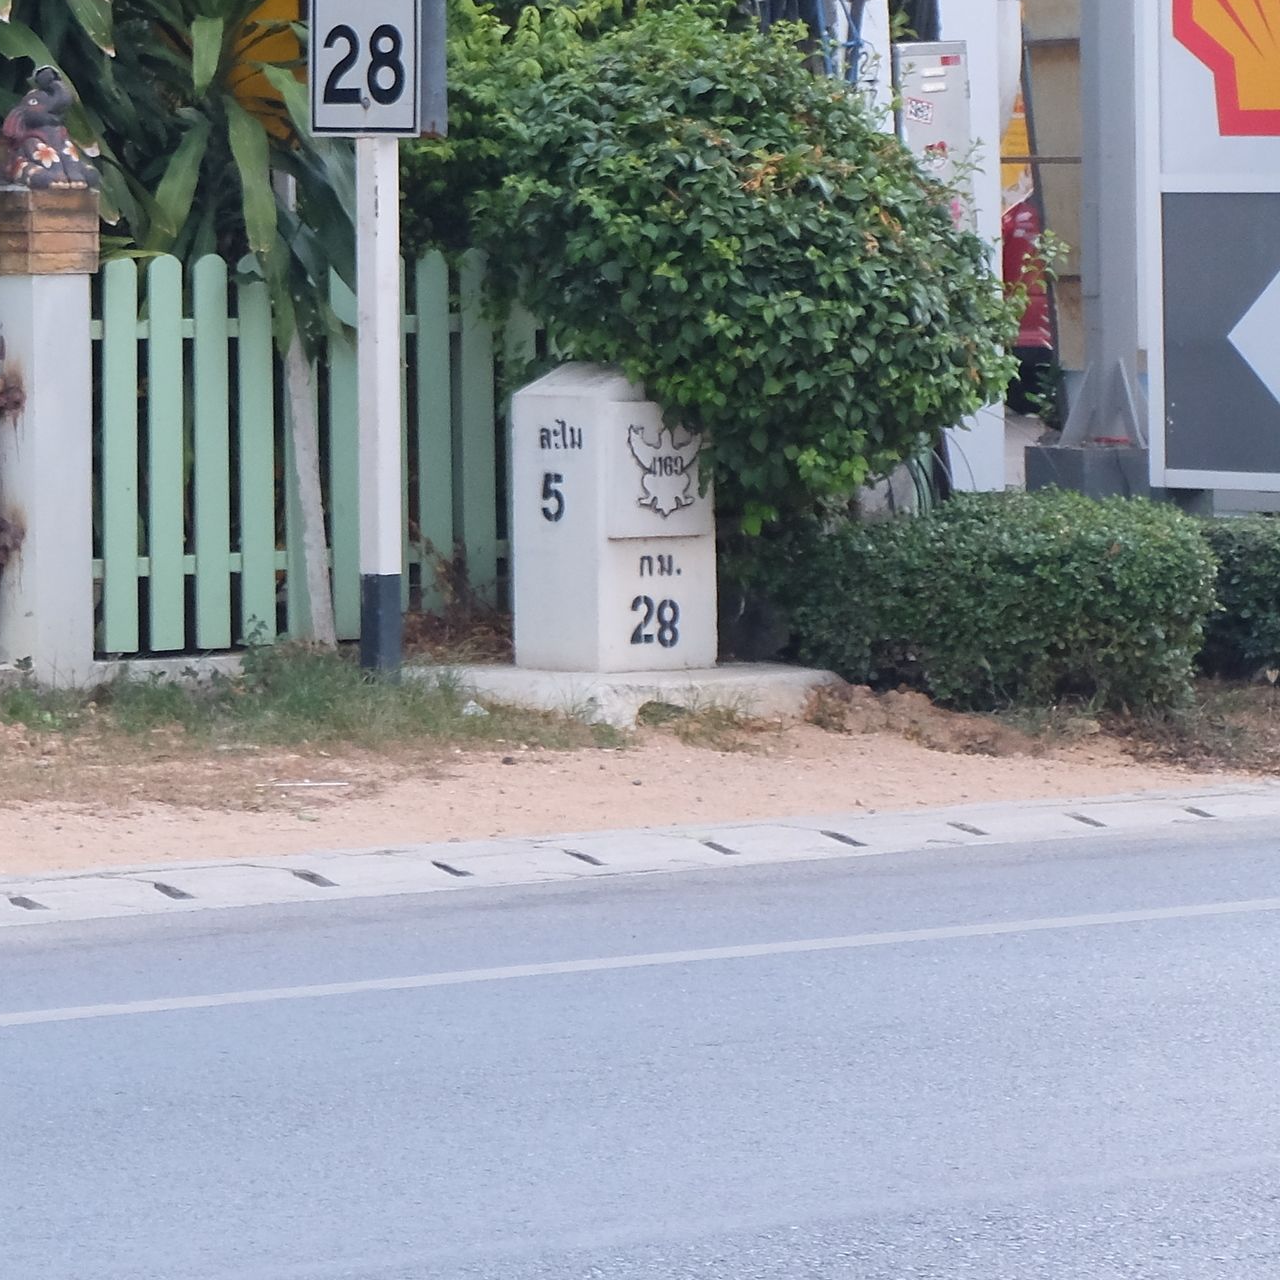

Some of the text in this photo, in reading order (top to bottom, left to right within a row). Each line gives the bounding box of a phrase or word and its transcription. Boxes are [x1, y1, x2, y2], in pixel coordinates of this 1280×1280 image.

[323, 24, 406, 106] 28
[541, 472, 566, 522] 5
[639, 553, 682, 577] กม.
[629, 595, 681, 649] 28
